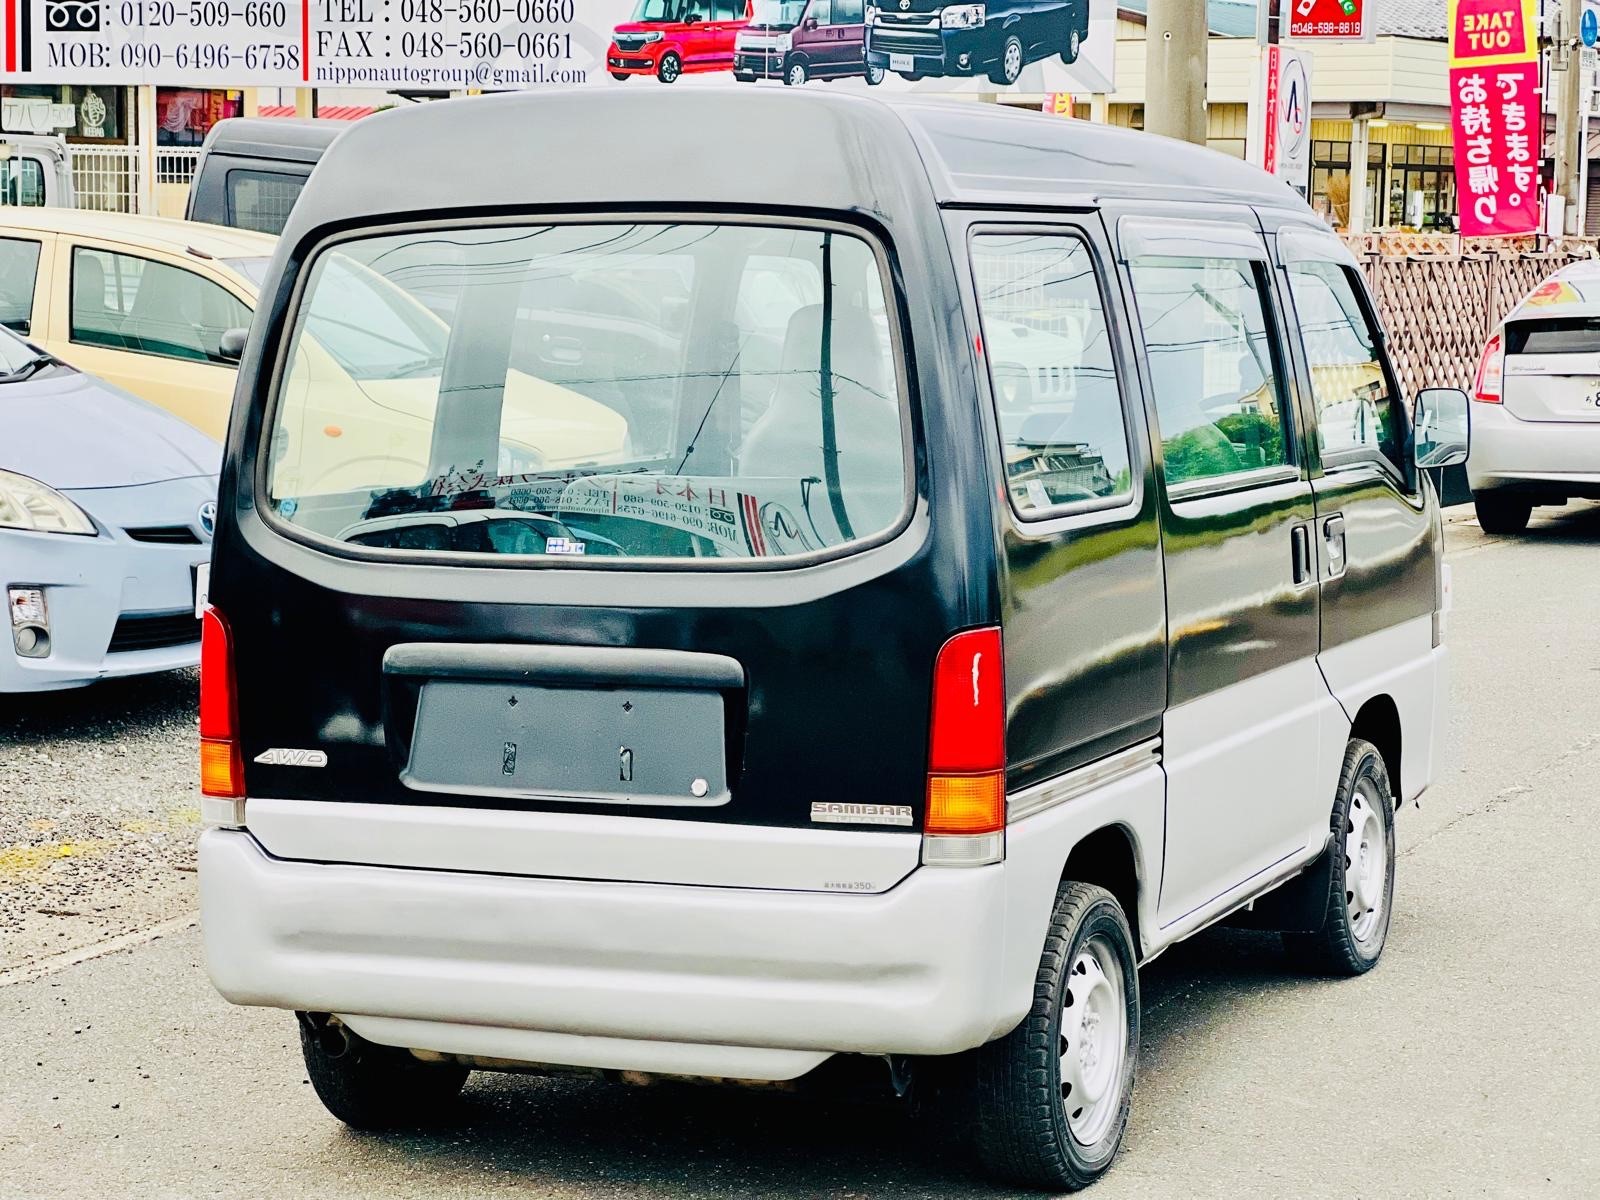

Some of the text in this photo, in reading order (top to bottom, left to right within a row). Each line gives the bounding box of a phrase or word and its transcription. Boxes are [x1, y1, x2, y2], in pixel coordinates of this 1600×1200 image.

[121, 1, 286, 27] 0120-509-660
[401, 0, 574, 24] 048-560-0660
[121, 43, 300, 70] 090-6496-6758
[402, 32, 573, 59] 048-560-0661
[316, 62, 587, 84] nipponautogroup@gmail.com
[254, 748, 328, 767] 4WD
[812, 803, 912, 816] SAMBAR
